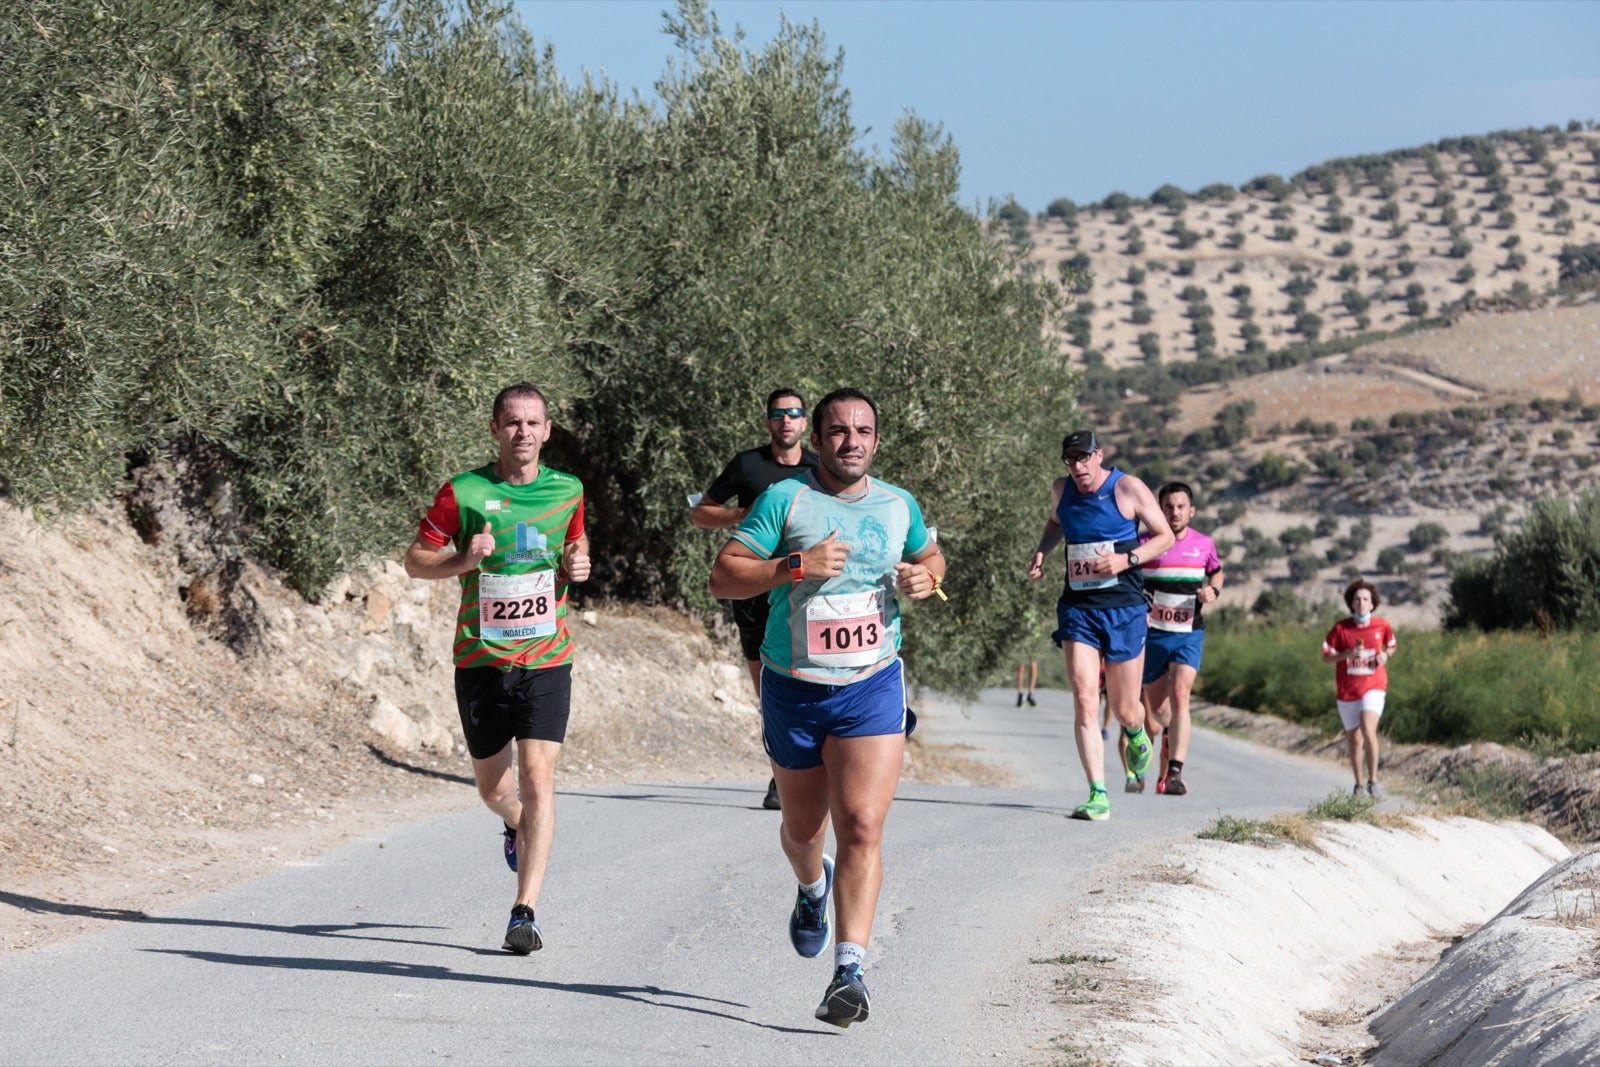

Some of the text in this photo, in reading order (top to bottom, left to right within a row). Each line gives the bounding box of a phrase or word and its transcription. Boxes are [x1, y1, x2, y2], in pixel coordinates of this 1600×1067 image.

[492, 596, 548, 620] 2228
[1158, 609, 1189, 623] 1063
[820, 623, 878, 650] 1013
